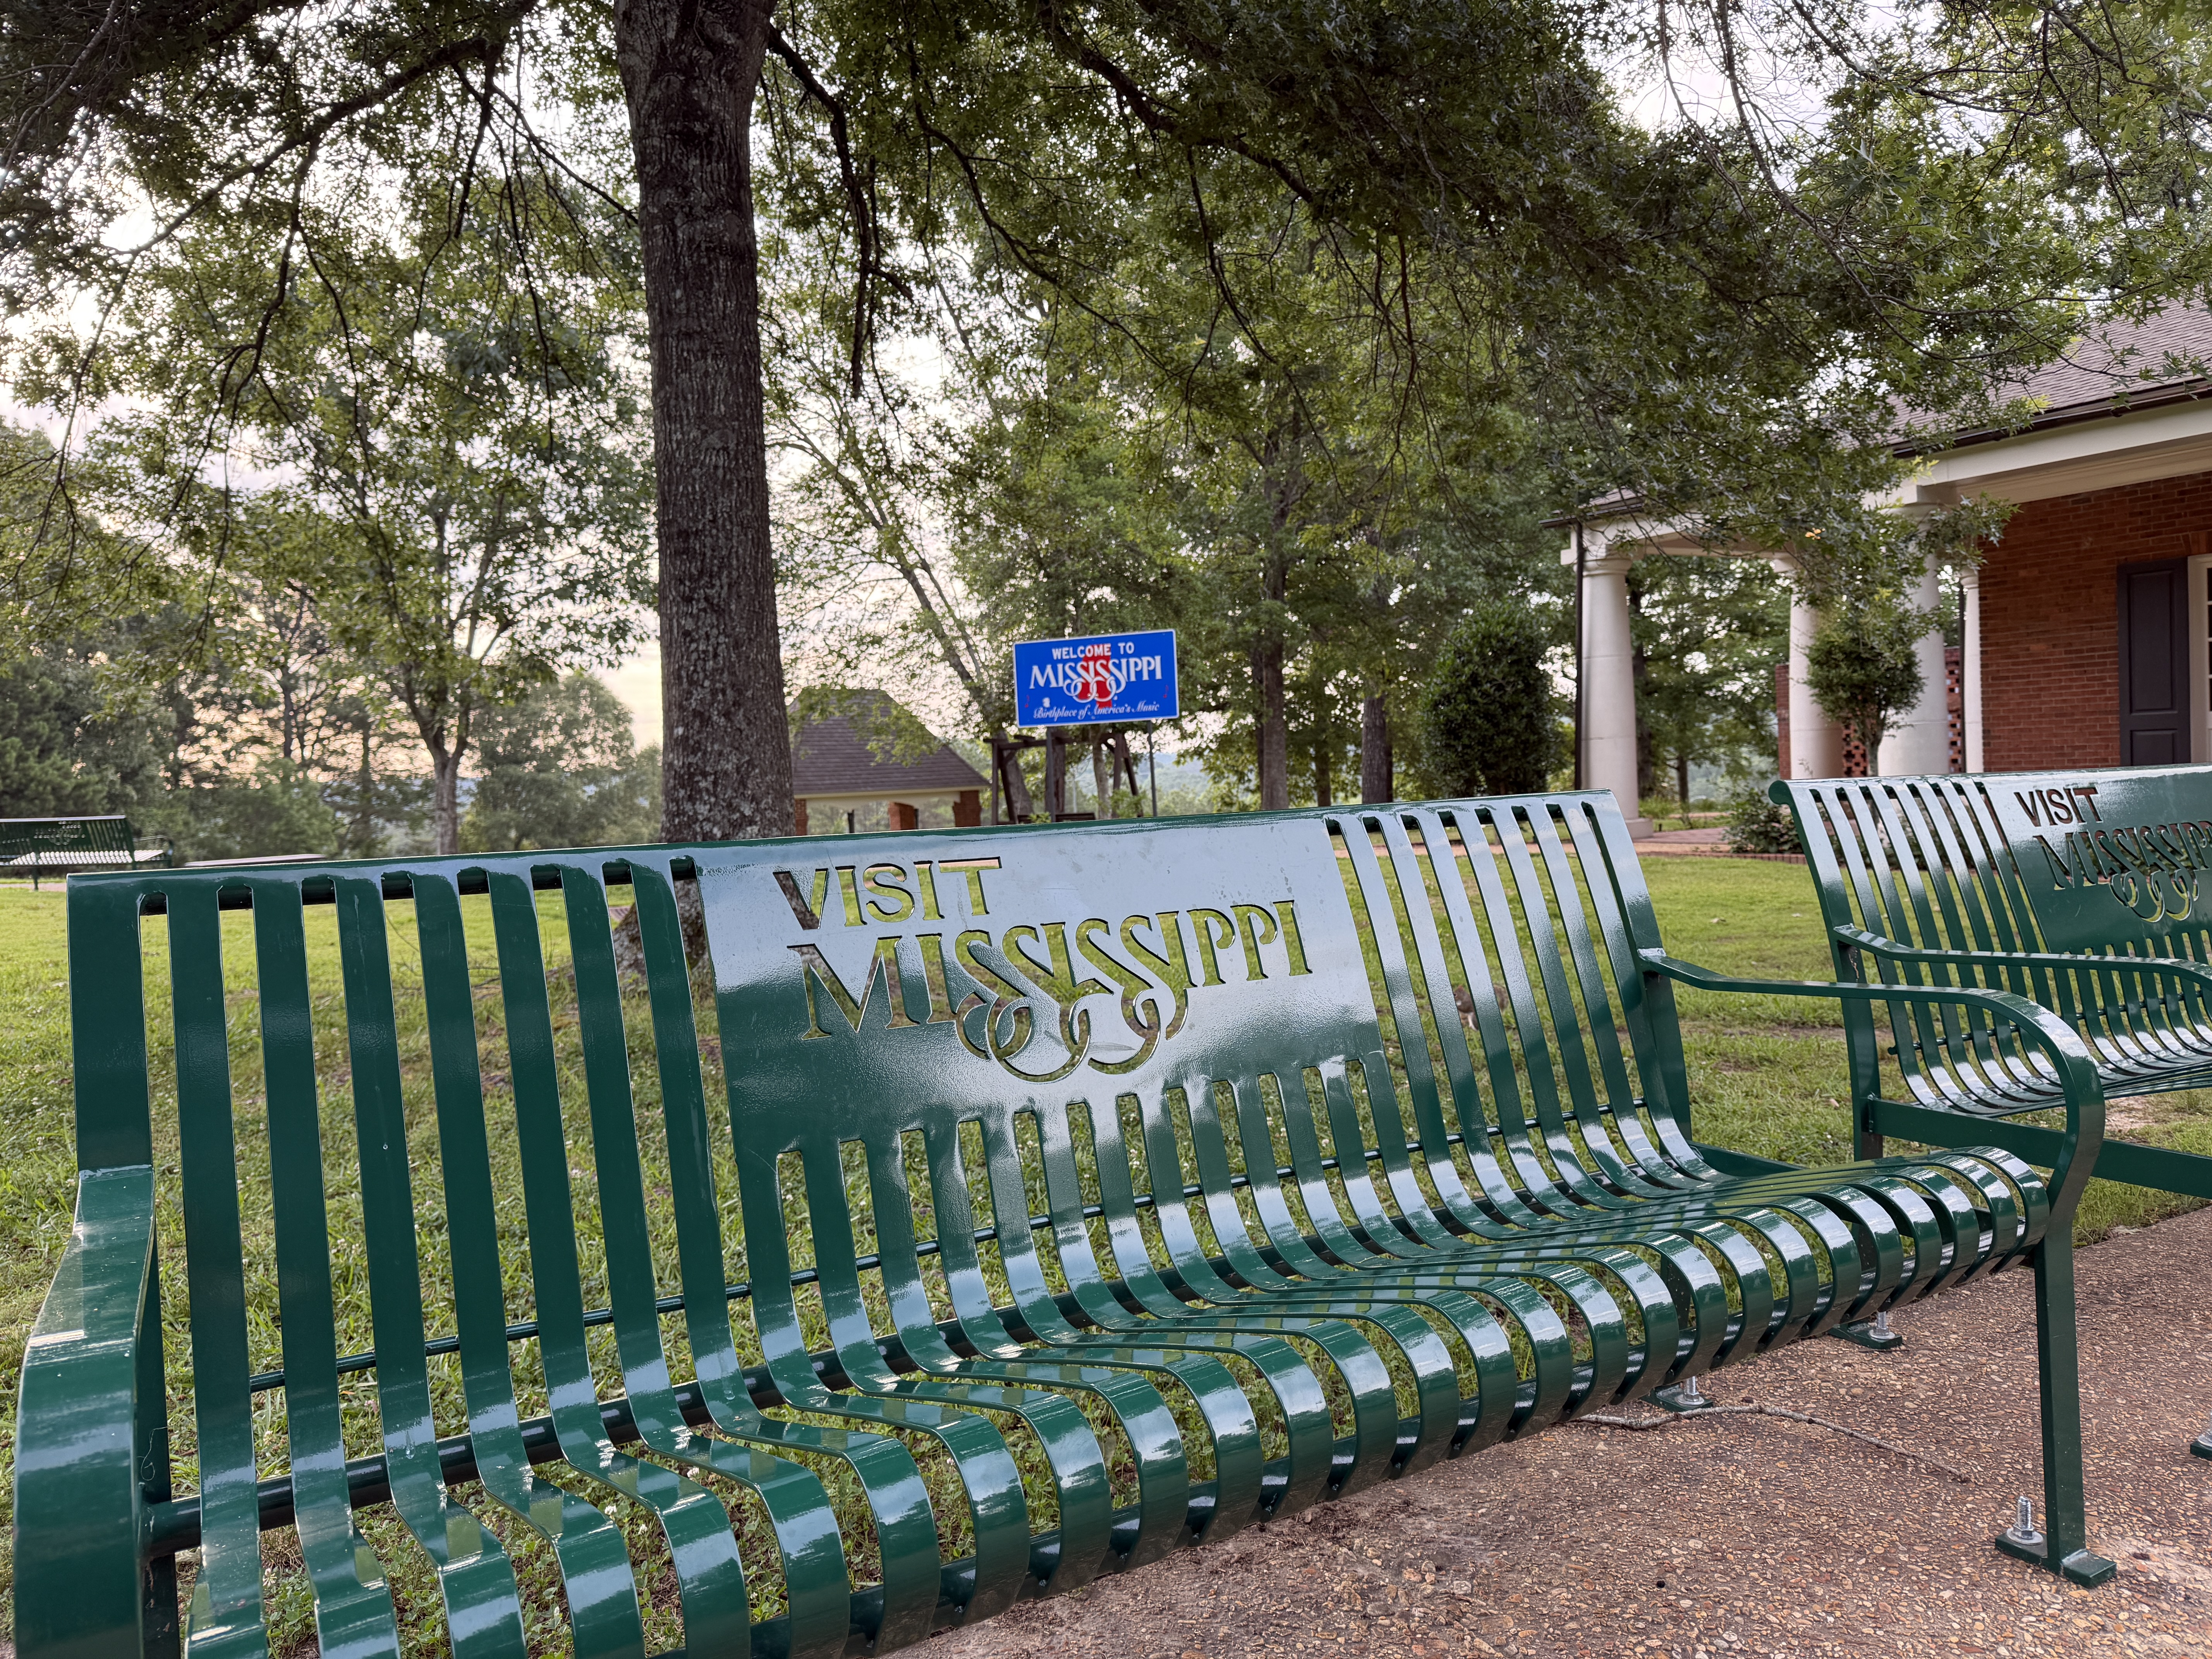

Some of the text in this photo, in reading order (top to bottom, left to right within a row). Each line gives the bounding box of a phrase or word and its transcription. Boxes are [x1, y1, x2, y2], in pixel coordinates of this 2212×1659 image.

[1052, 642, 1135, 660] WELCOME TO
[1029, 655, 1162, 703] MISSISSIPPI
[1033, 700, 1159, 721] Birthplace of America's Music
[2014, 787, 2104, 827] VISIT
[774, 857, 1002, 930] VISIT
[787, 900, 1313, 1083] MISSISSIPPI
